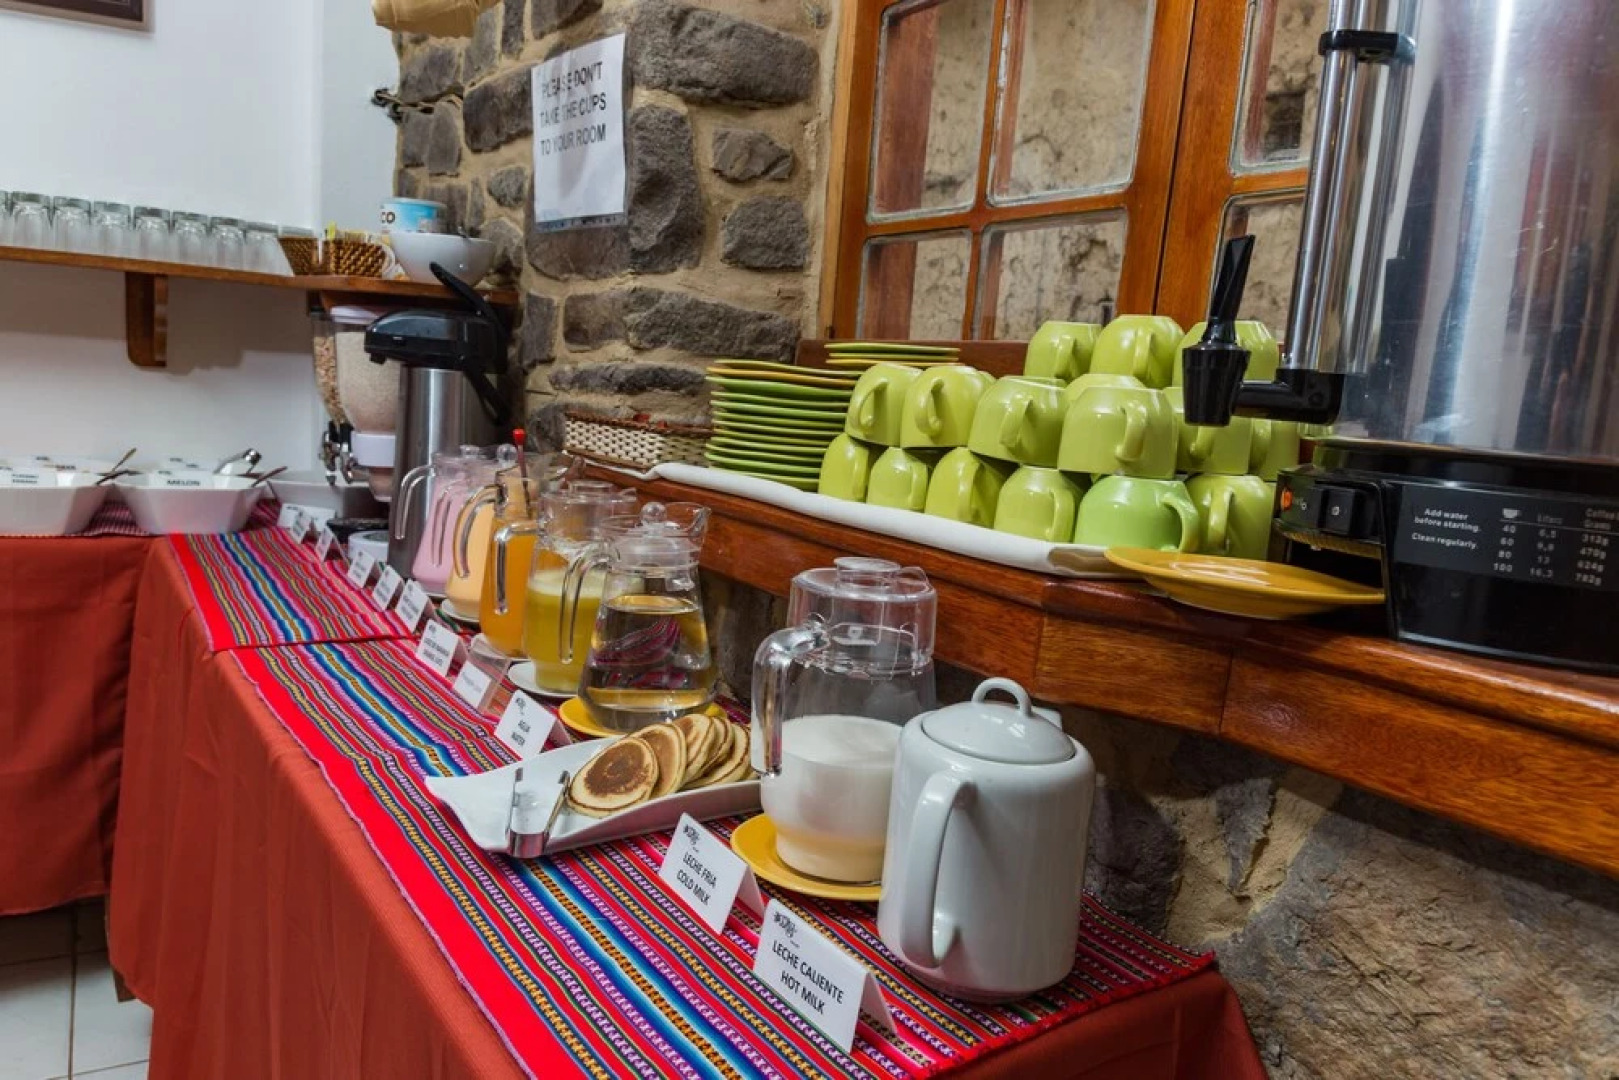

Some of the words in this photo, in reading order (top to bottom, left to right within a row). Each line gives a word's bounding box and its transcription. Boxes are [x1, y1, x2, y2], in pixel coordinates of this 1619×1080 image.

[542, 72, 572, 97] PLEASE
[575, 61, 602, 87] DON'T
[540, 106, 560, 128] TAKE
[562, 101, 577, 121] THE
[580, 92, 606, 115] CUPS
[540, 138, 551, 155] TO
[553, 131, 575, 152] YOUR
[576, 123, 606, 147] ROOM
[1414, 516, 1441, 526] before
[1424, 508, 1442, 517] Add
[1443, 512, 1468, 521] water
[1412, 532, 1435, 542] Clean
[1493, 562, 1513, 572] 100
[676, 869, 694, 890] COLD
[693, 883, 711, 906] MILK
[682, 851, 702, 875] LECHE
[701, 868, 717, 889] FRIA
[772, 940, 799, 969] LECHE
[800, 961, 844, 1005] CALIENTE
[781, 969, 801, 994] HOT
[800, 986, 825, 1015] MILK
